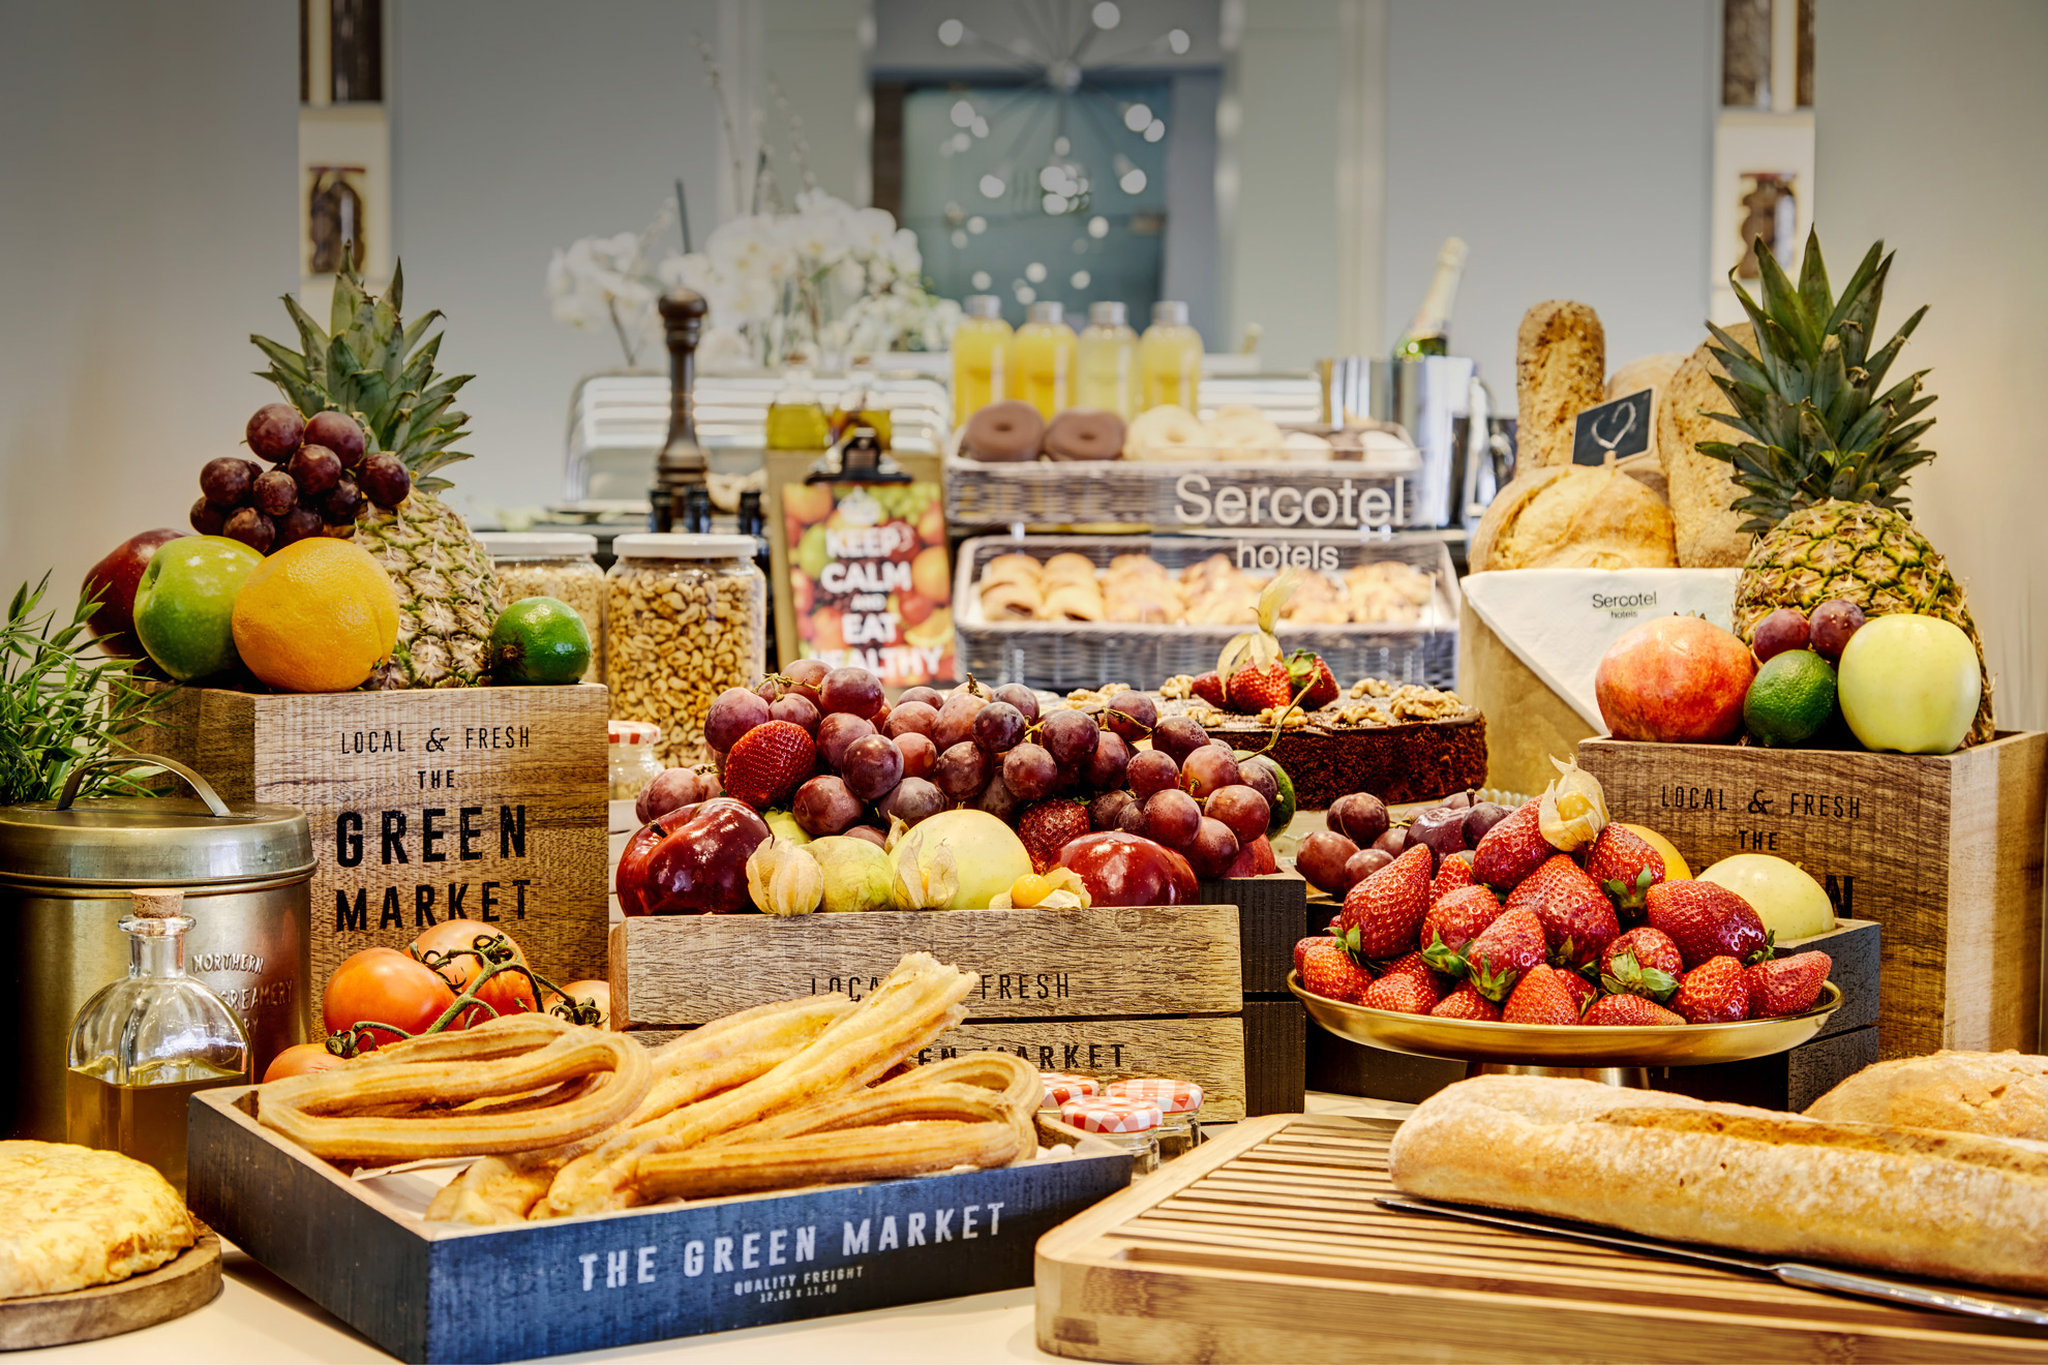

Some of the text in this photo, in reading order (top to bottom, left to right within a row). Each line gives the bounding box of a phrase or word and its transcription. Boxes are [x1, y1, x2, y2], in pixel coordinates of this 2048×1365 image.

[1174, 473, 1405, 526] Sercotel
[826, 526, 900, 558] KEEP
[1236, 540, 1340, 570] hotels
[821, 561, 913, 594] CALM
[1592, 591, 1657, 609] Sercotel
[1611, 610, 1638, 619] hotels
[841, 613, 900, 645] EAT
[341, 726, 530, 755] LOCAL & FRESH
[417, 769, 455, 789] THE
[1662, 786, 1860, 819] LOCAL & FRESH
[336, 804, 526, 868] GREEN
[1738, 830, 1778, 851] THE
[336, 879, 531, 932] MARKET
[192, 953, 264, 975] NORTHERN
[981, 972, 1070, 1000] FRESH
[982, 1044, 1125, 1070] ARKET
[578, 1202, 1006, 1292] THE GREEN MARKET
[734, 1266, 863, 1296] QUALITY FREIGHT
